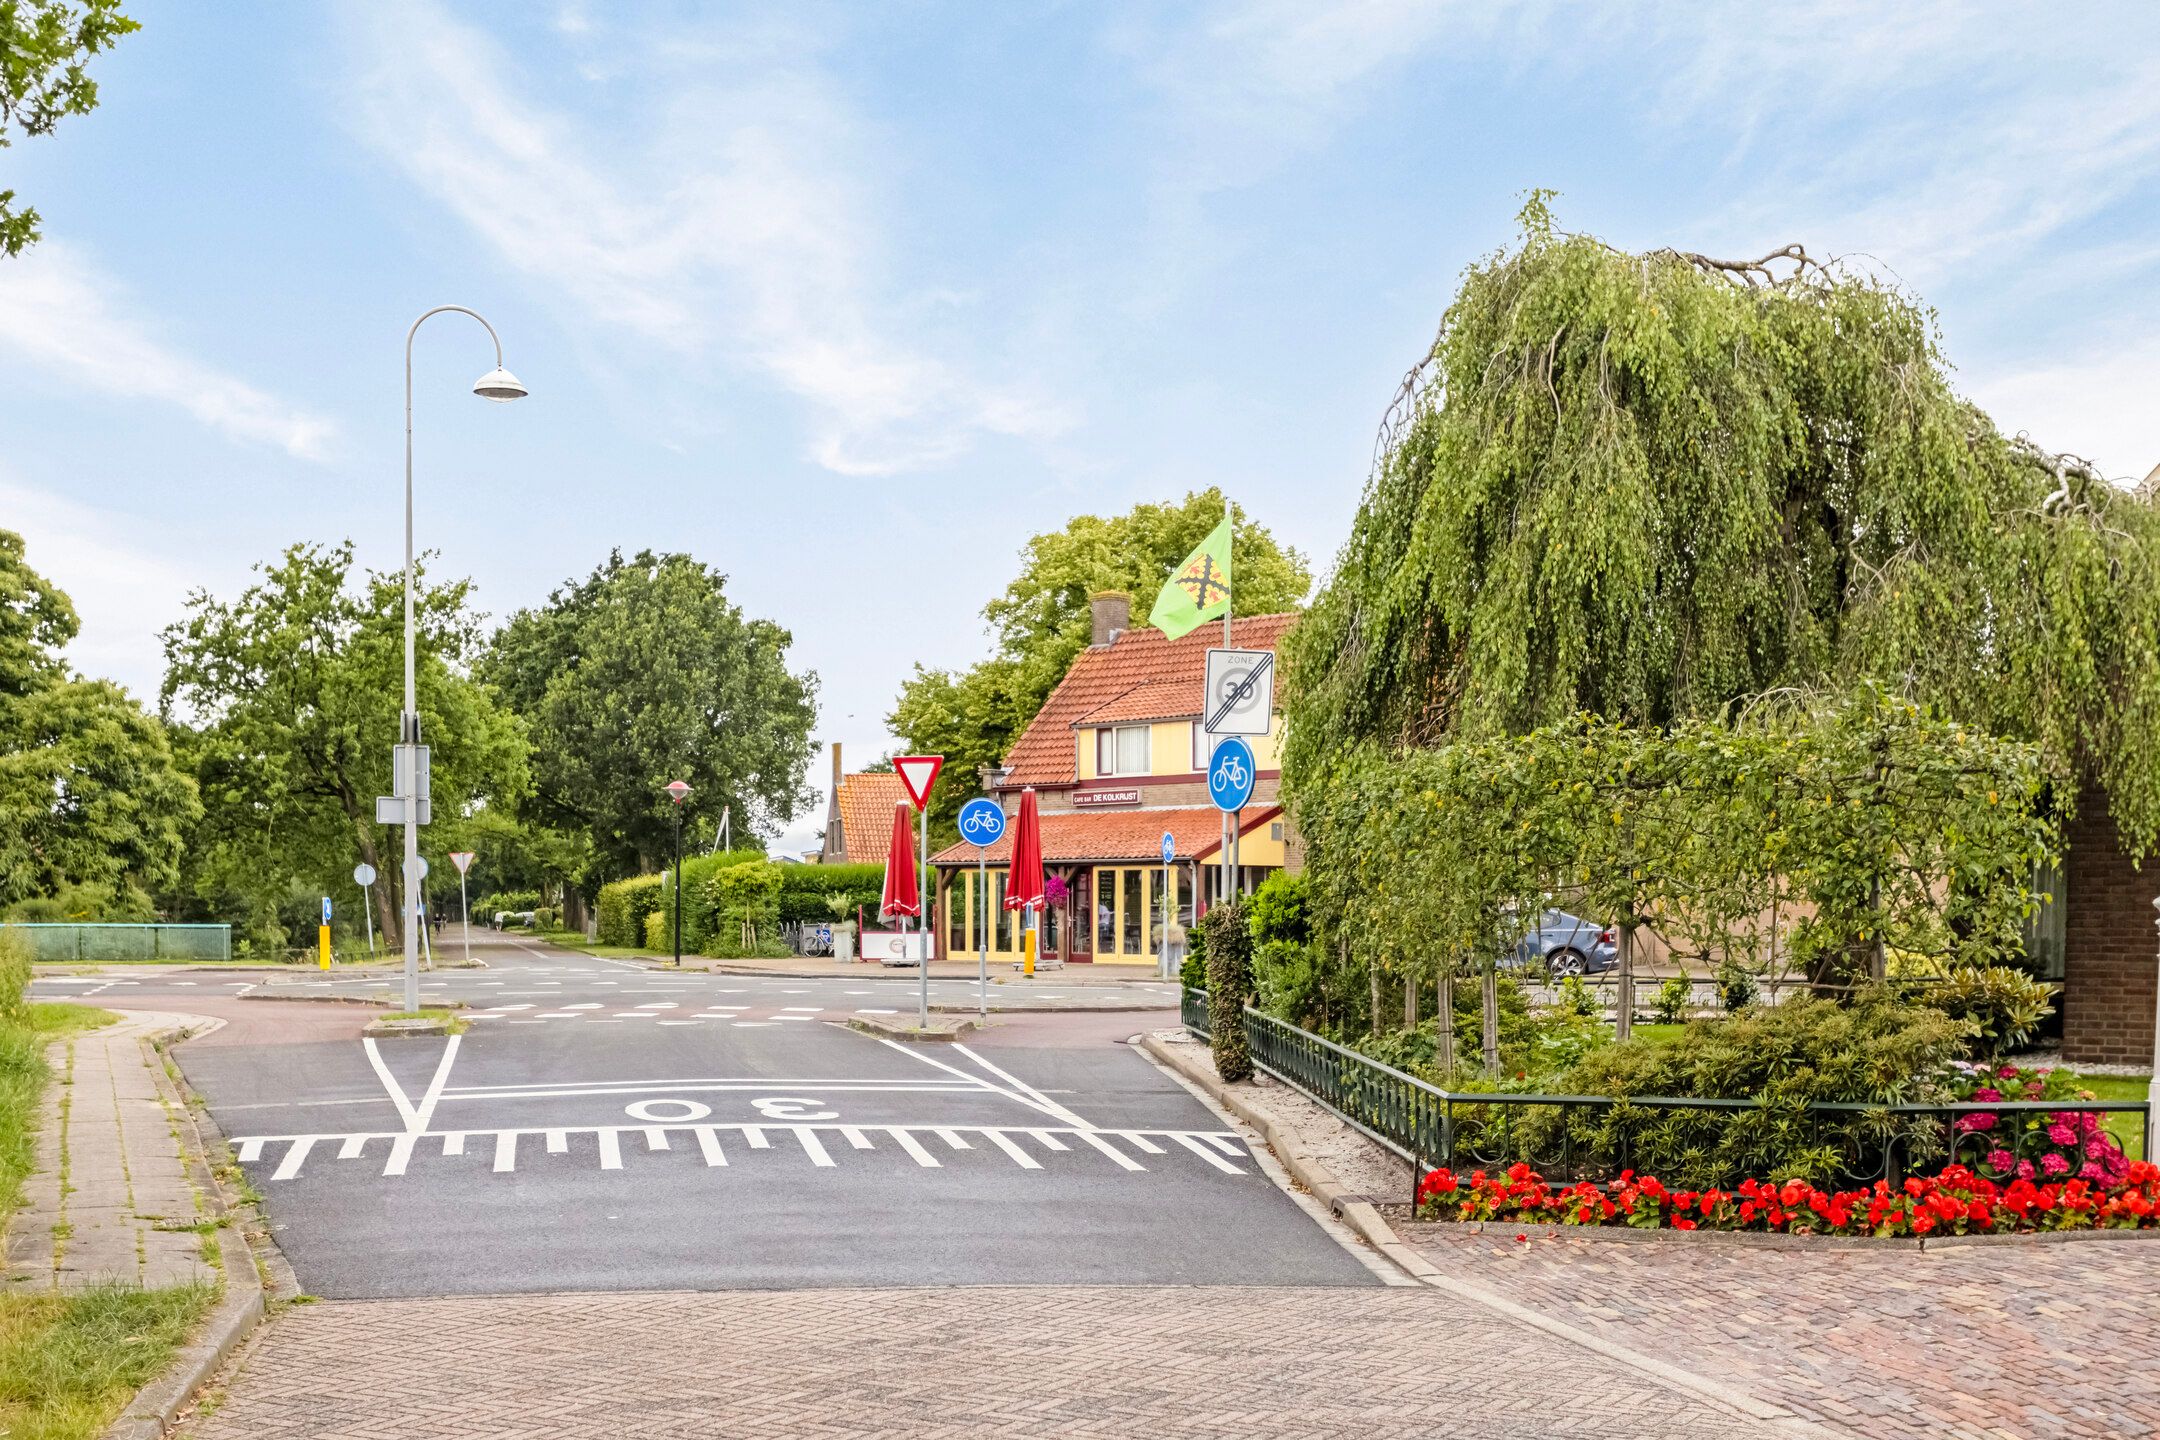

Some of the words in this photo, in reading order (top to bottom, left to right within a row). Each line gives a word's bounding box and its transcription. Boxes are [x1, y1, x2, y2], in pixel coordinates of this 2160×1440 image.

[1227, 656, 1254, 665] ZONE
[1225, 681, 1254, 701] 30
[1093, 794, 1102, 802] DE
